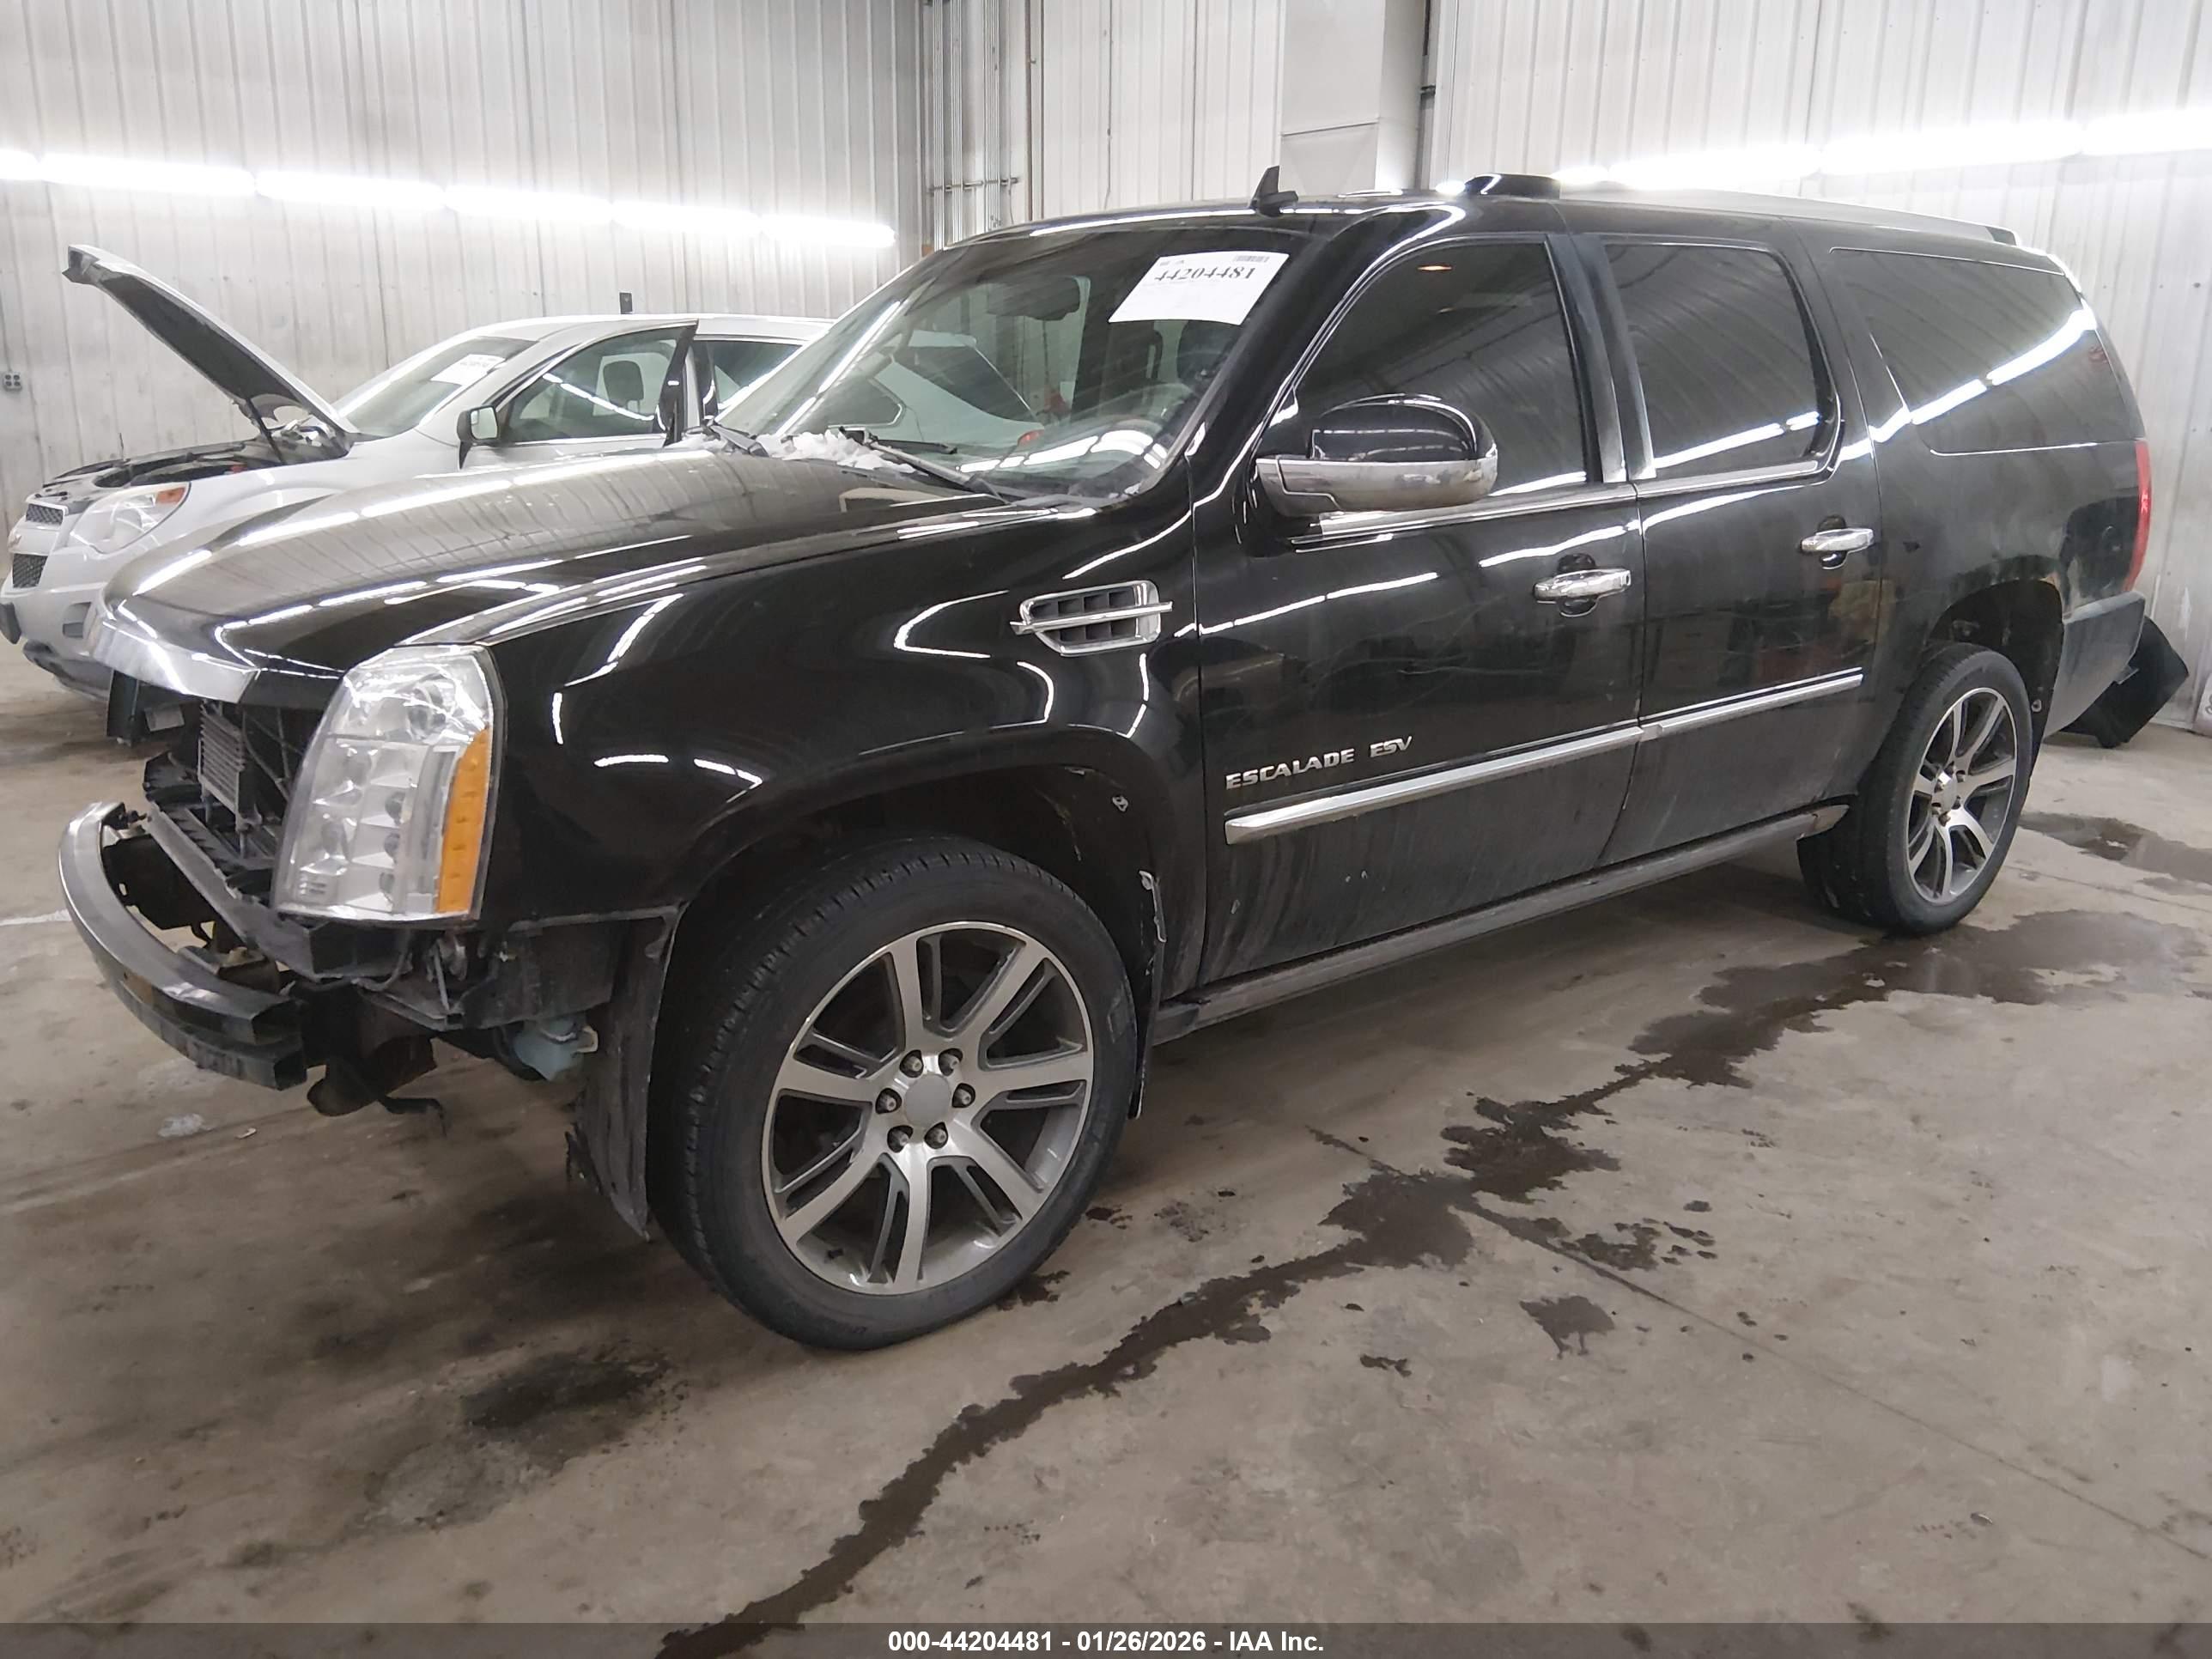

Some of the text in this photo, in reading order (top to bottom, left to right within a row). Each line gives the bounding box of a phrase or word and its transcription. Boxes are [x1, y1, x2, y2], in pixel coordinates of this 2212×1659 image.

[1154, 266, 1255, 281] 44204481
[1225, 735, 1413, 790] ESCALADE ESV
